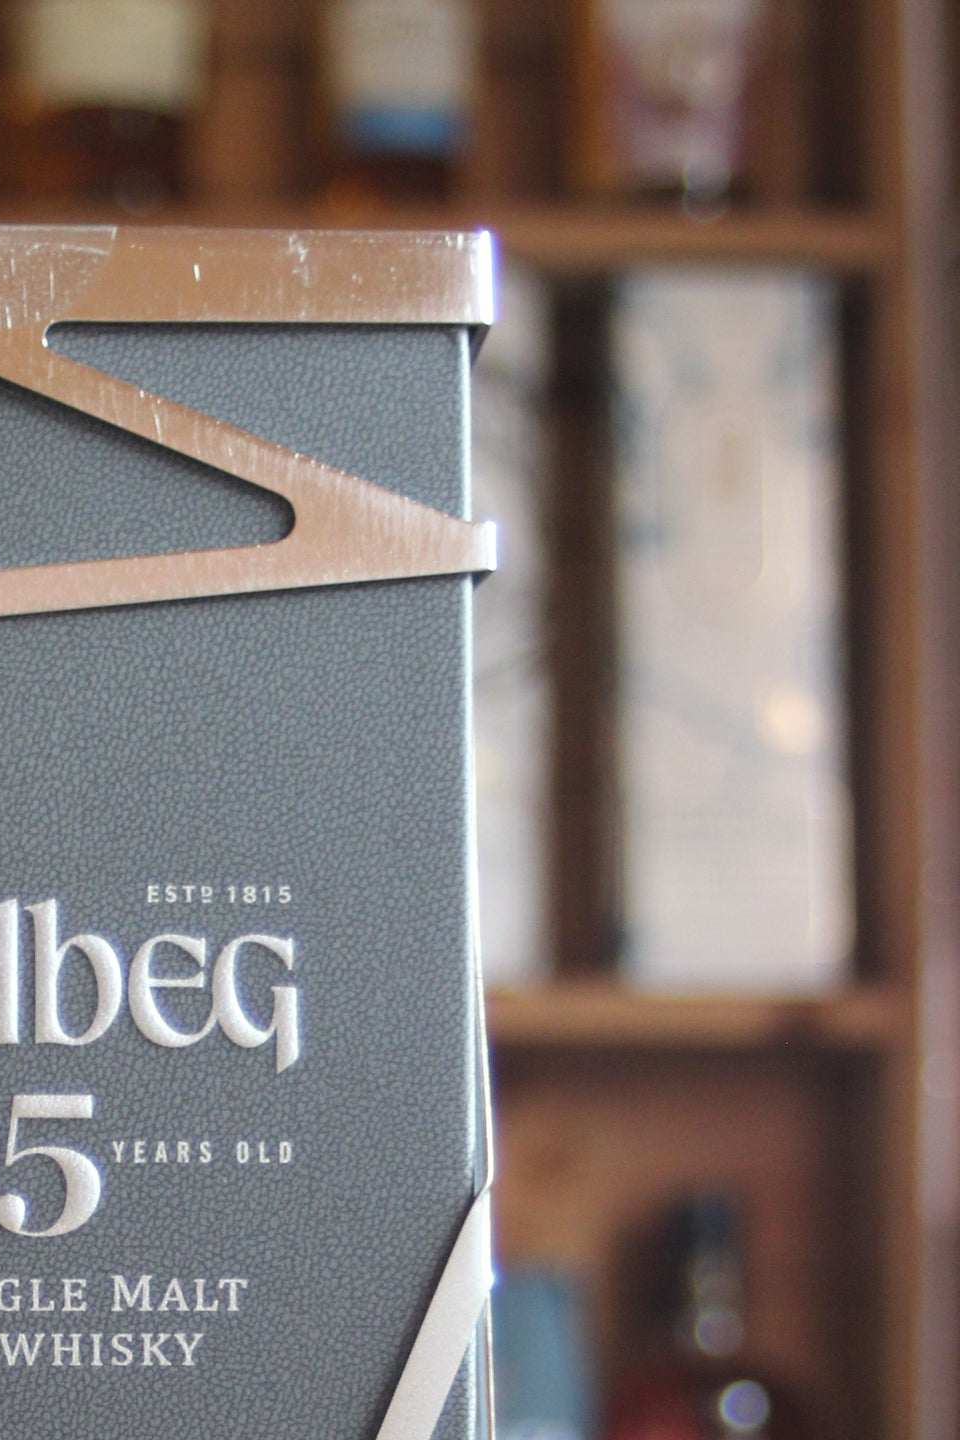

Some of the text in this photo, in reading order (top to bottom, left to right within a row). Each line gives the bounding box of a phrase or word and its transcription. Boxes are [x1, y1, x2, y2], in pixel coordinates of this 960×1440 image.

[227, 884, 292, 904] 1815
[112, 1140, 213, 1164] YEARS
[236, 1139, 292, 1164] OLD
